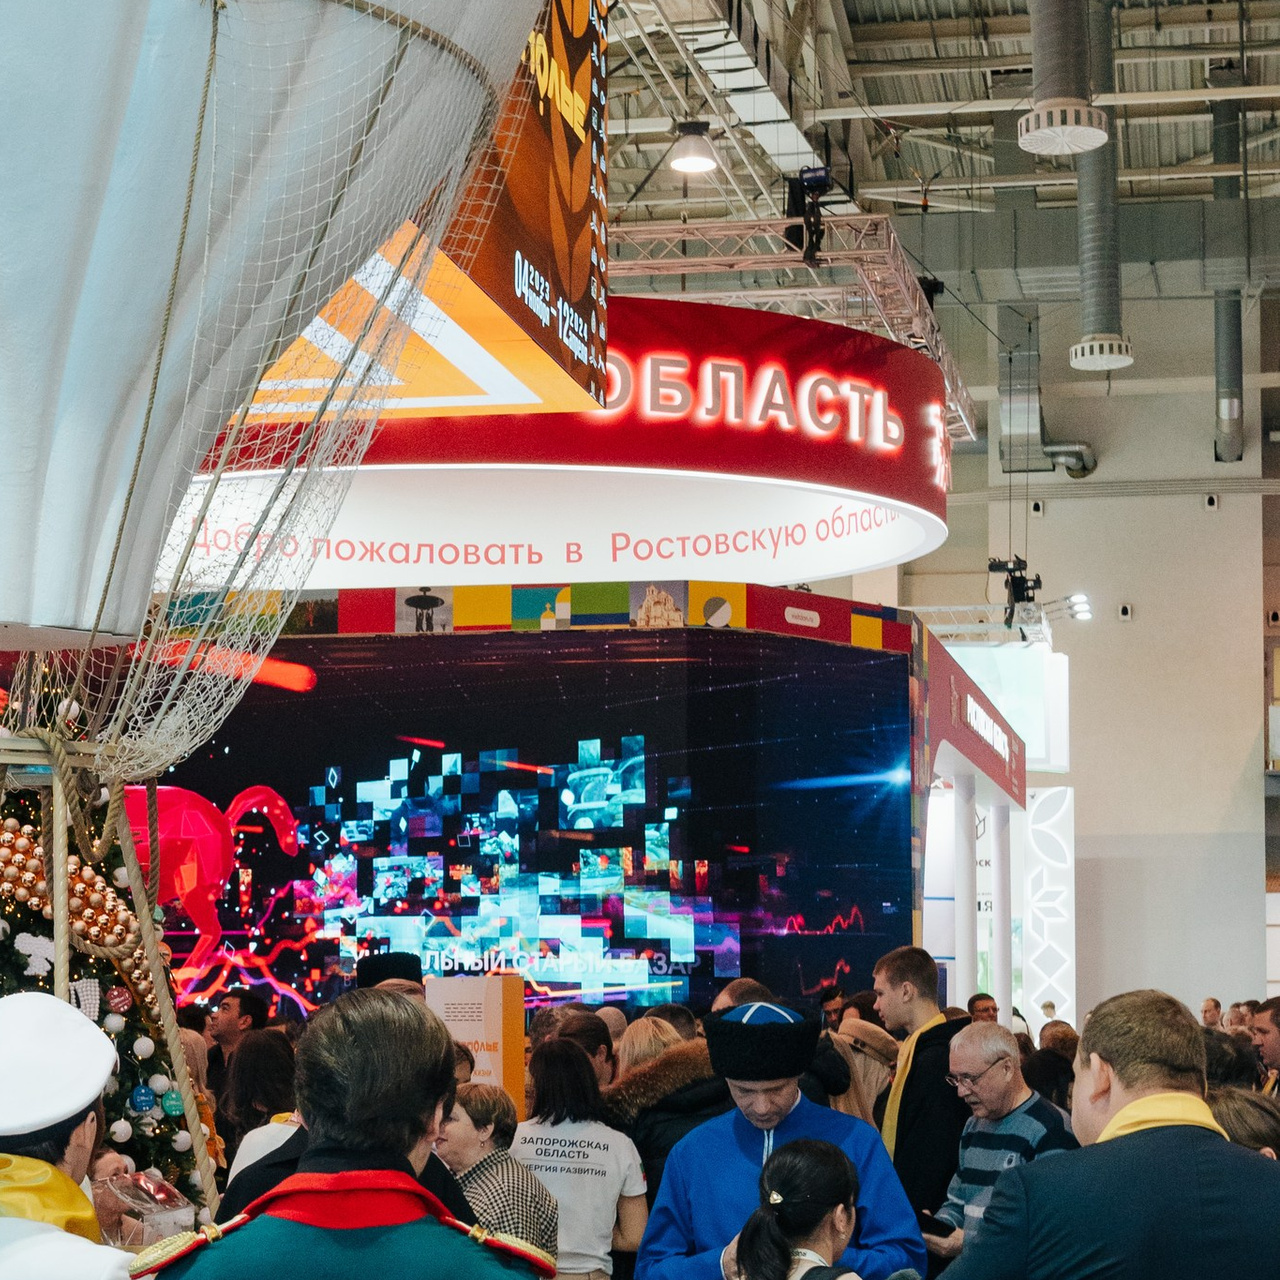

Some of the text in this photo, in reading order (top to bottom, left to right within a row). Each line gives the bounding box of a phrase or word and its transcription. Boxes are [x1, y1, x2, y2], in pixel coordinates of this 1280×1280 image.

[514, 249, 551, 305] 04 2023
[556, 295, 571, 347] 12
[192, 516, 299, 563] Добро
[311, 537, 544, 566] пожаловать
[565, 541, 584, 564] в
[610, 521, 807, 564] Ростовскую
[520, 1136, 610, 1152] ЗАПОРОЖСКАЯ
[535, 1147, 590, 1160] ОБЛАСТЬ
[523, 1163, 607, 1178] НЕРГИЯ РАЗВИТИЯ
